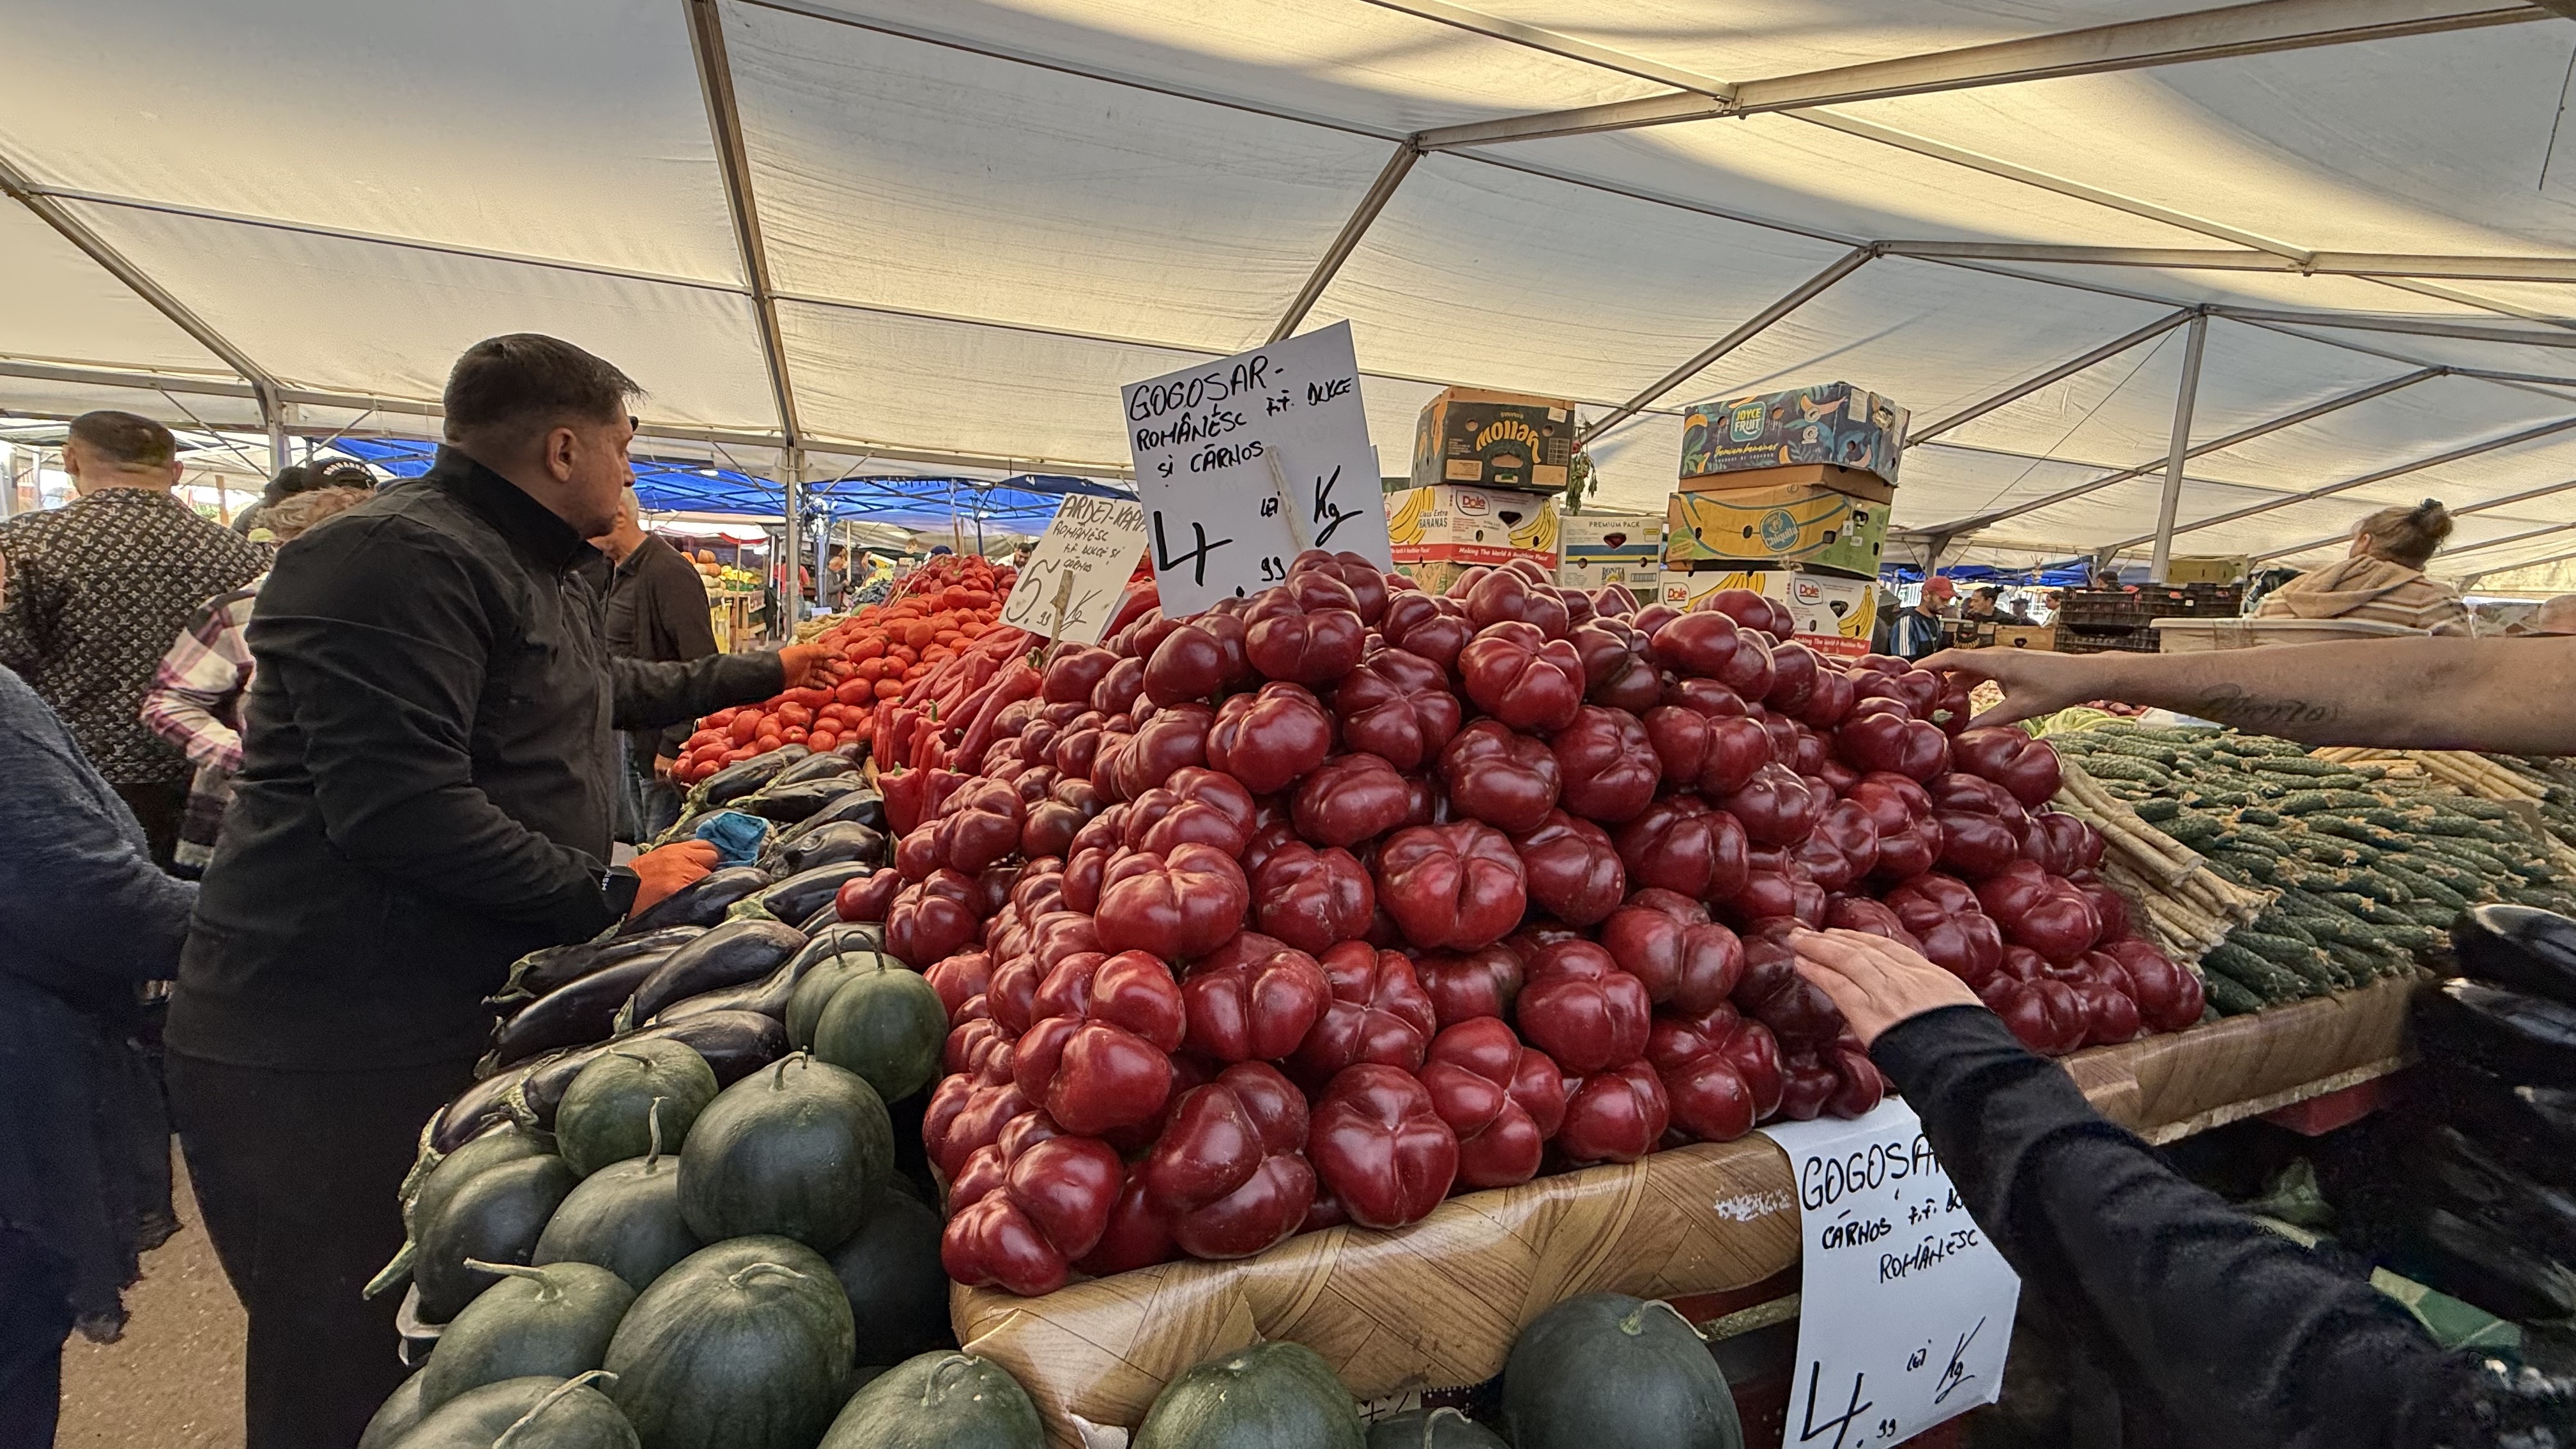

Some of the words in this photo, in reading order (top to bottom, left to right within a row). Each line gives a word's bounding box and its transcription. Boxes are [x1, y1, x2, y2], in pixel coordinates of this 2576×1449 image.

[1736, 408, 1762, 421] JOYCE
[1734, 418, 1760, 434] FRUIT
[1462, 495, 1486, 507] Dole
[1419, 518, 1448, 528] BANANAS
[1765, 526, 1799, 547] Chiquita
[1459, 547, 1478, 556] Making
[1601, 567, 1625, 581] BONITA
[1667, 588, 1687, 599] Dole
[1800, 584, 1819, 595] Dole
